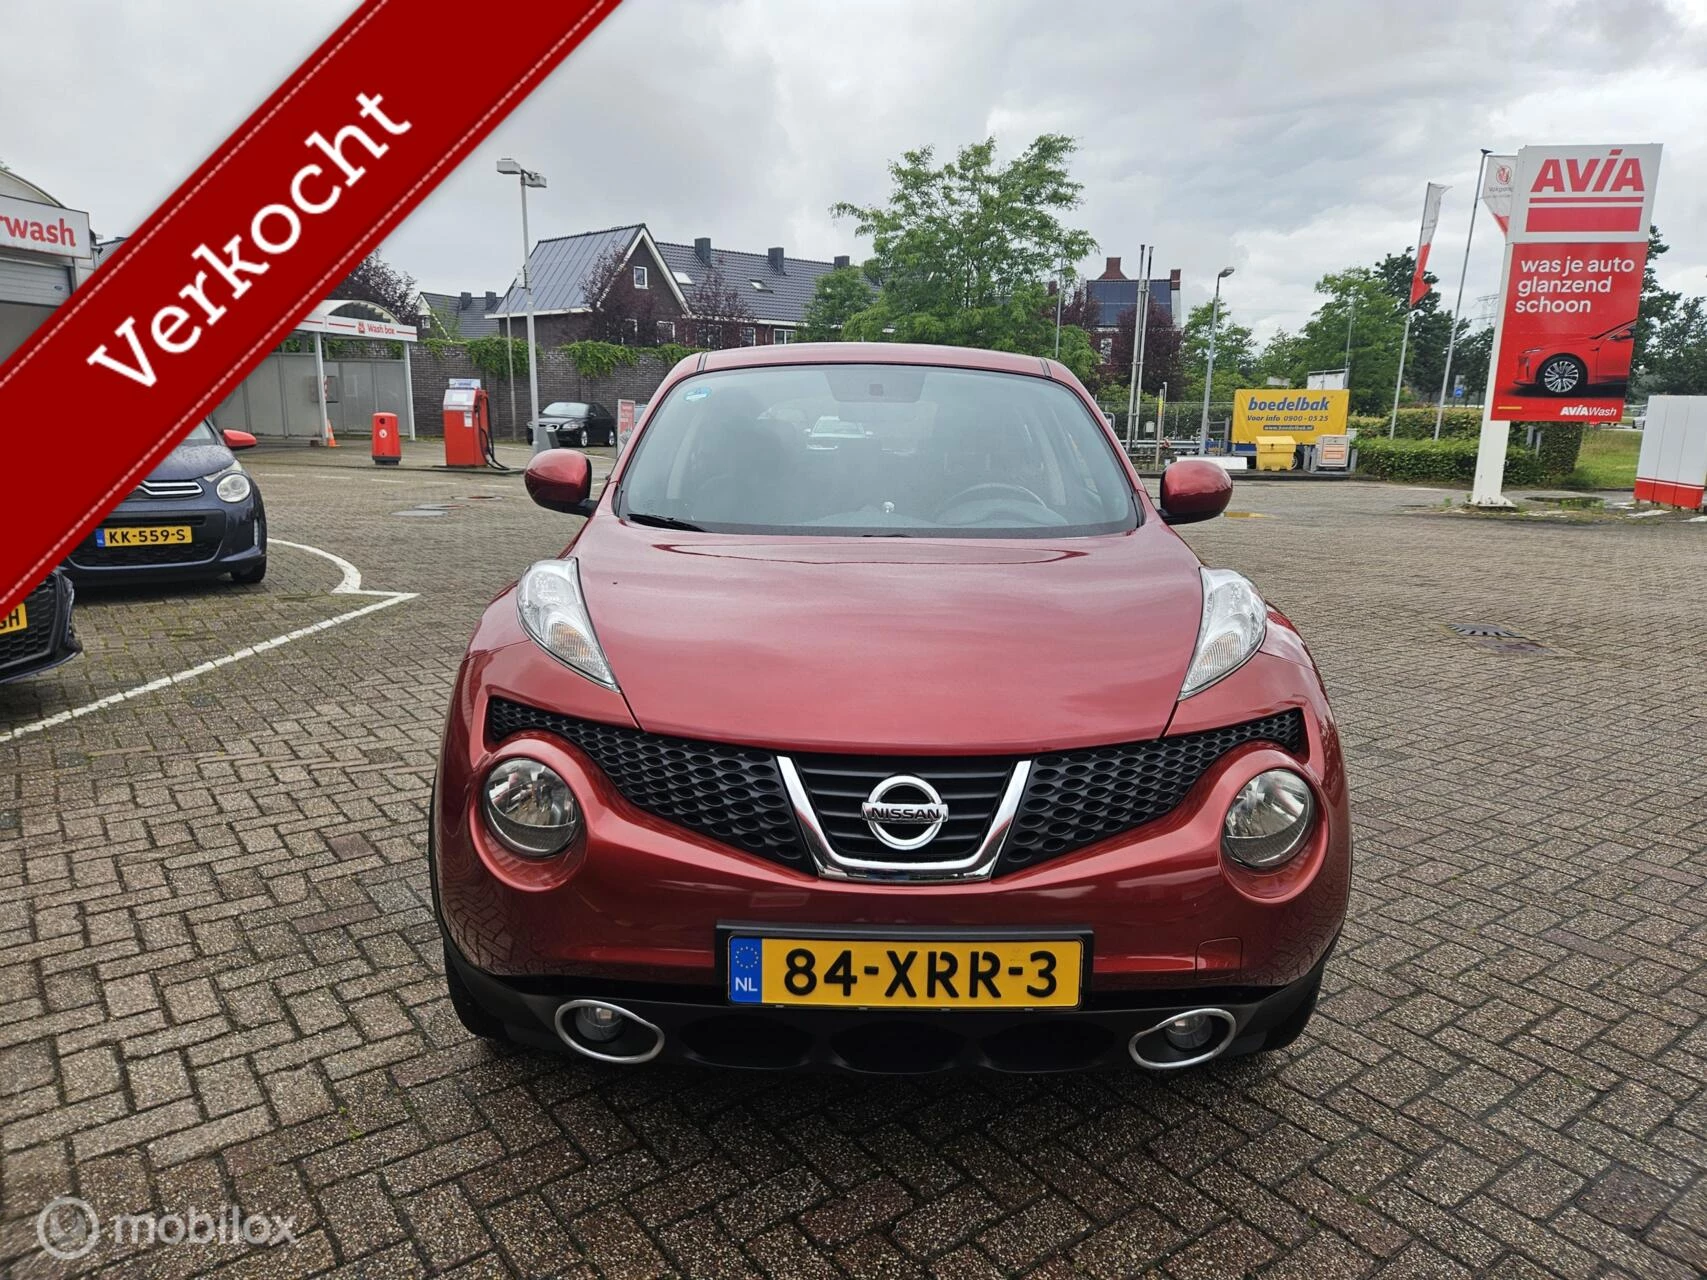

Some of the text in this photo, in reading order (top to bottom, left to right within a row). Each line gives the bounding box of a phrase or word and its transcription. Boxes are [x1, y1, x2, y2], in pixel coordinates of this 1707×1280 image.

[1521, 256, 1635, 277] was je auto
[1517, 276, 1612, 297] glanzend
[1515, 296, 1591, 313] schoon
[1248, 396, 1330, 411] boedelbak
[1247, 414, 1264, 422] Voor
[1266, 414, 1280, 422] info
[109, 529, 185, 544] KK-559-S
[871, 807, 940, 820] NISSAN
[784, 947, 1057, 998] 84-XRR-3
[734, 977, 758, 992] NL
